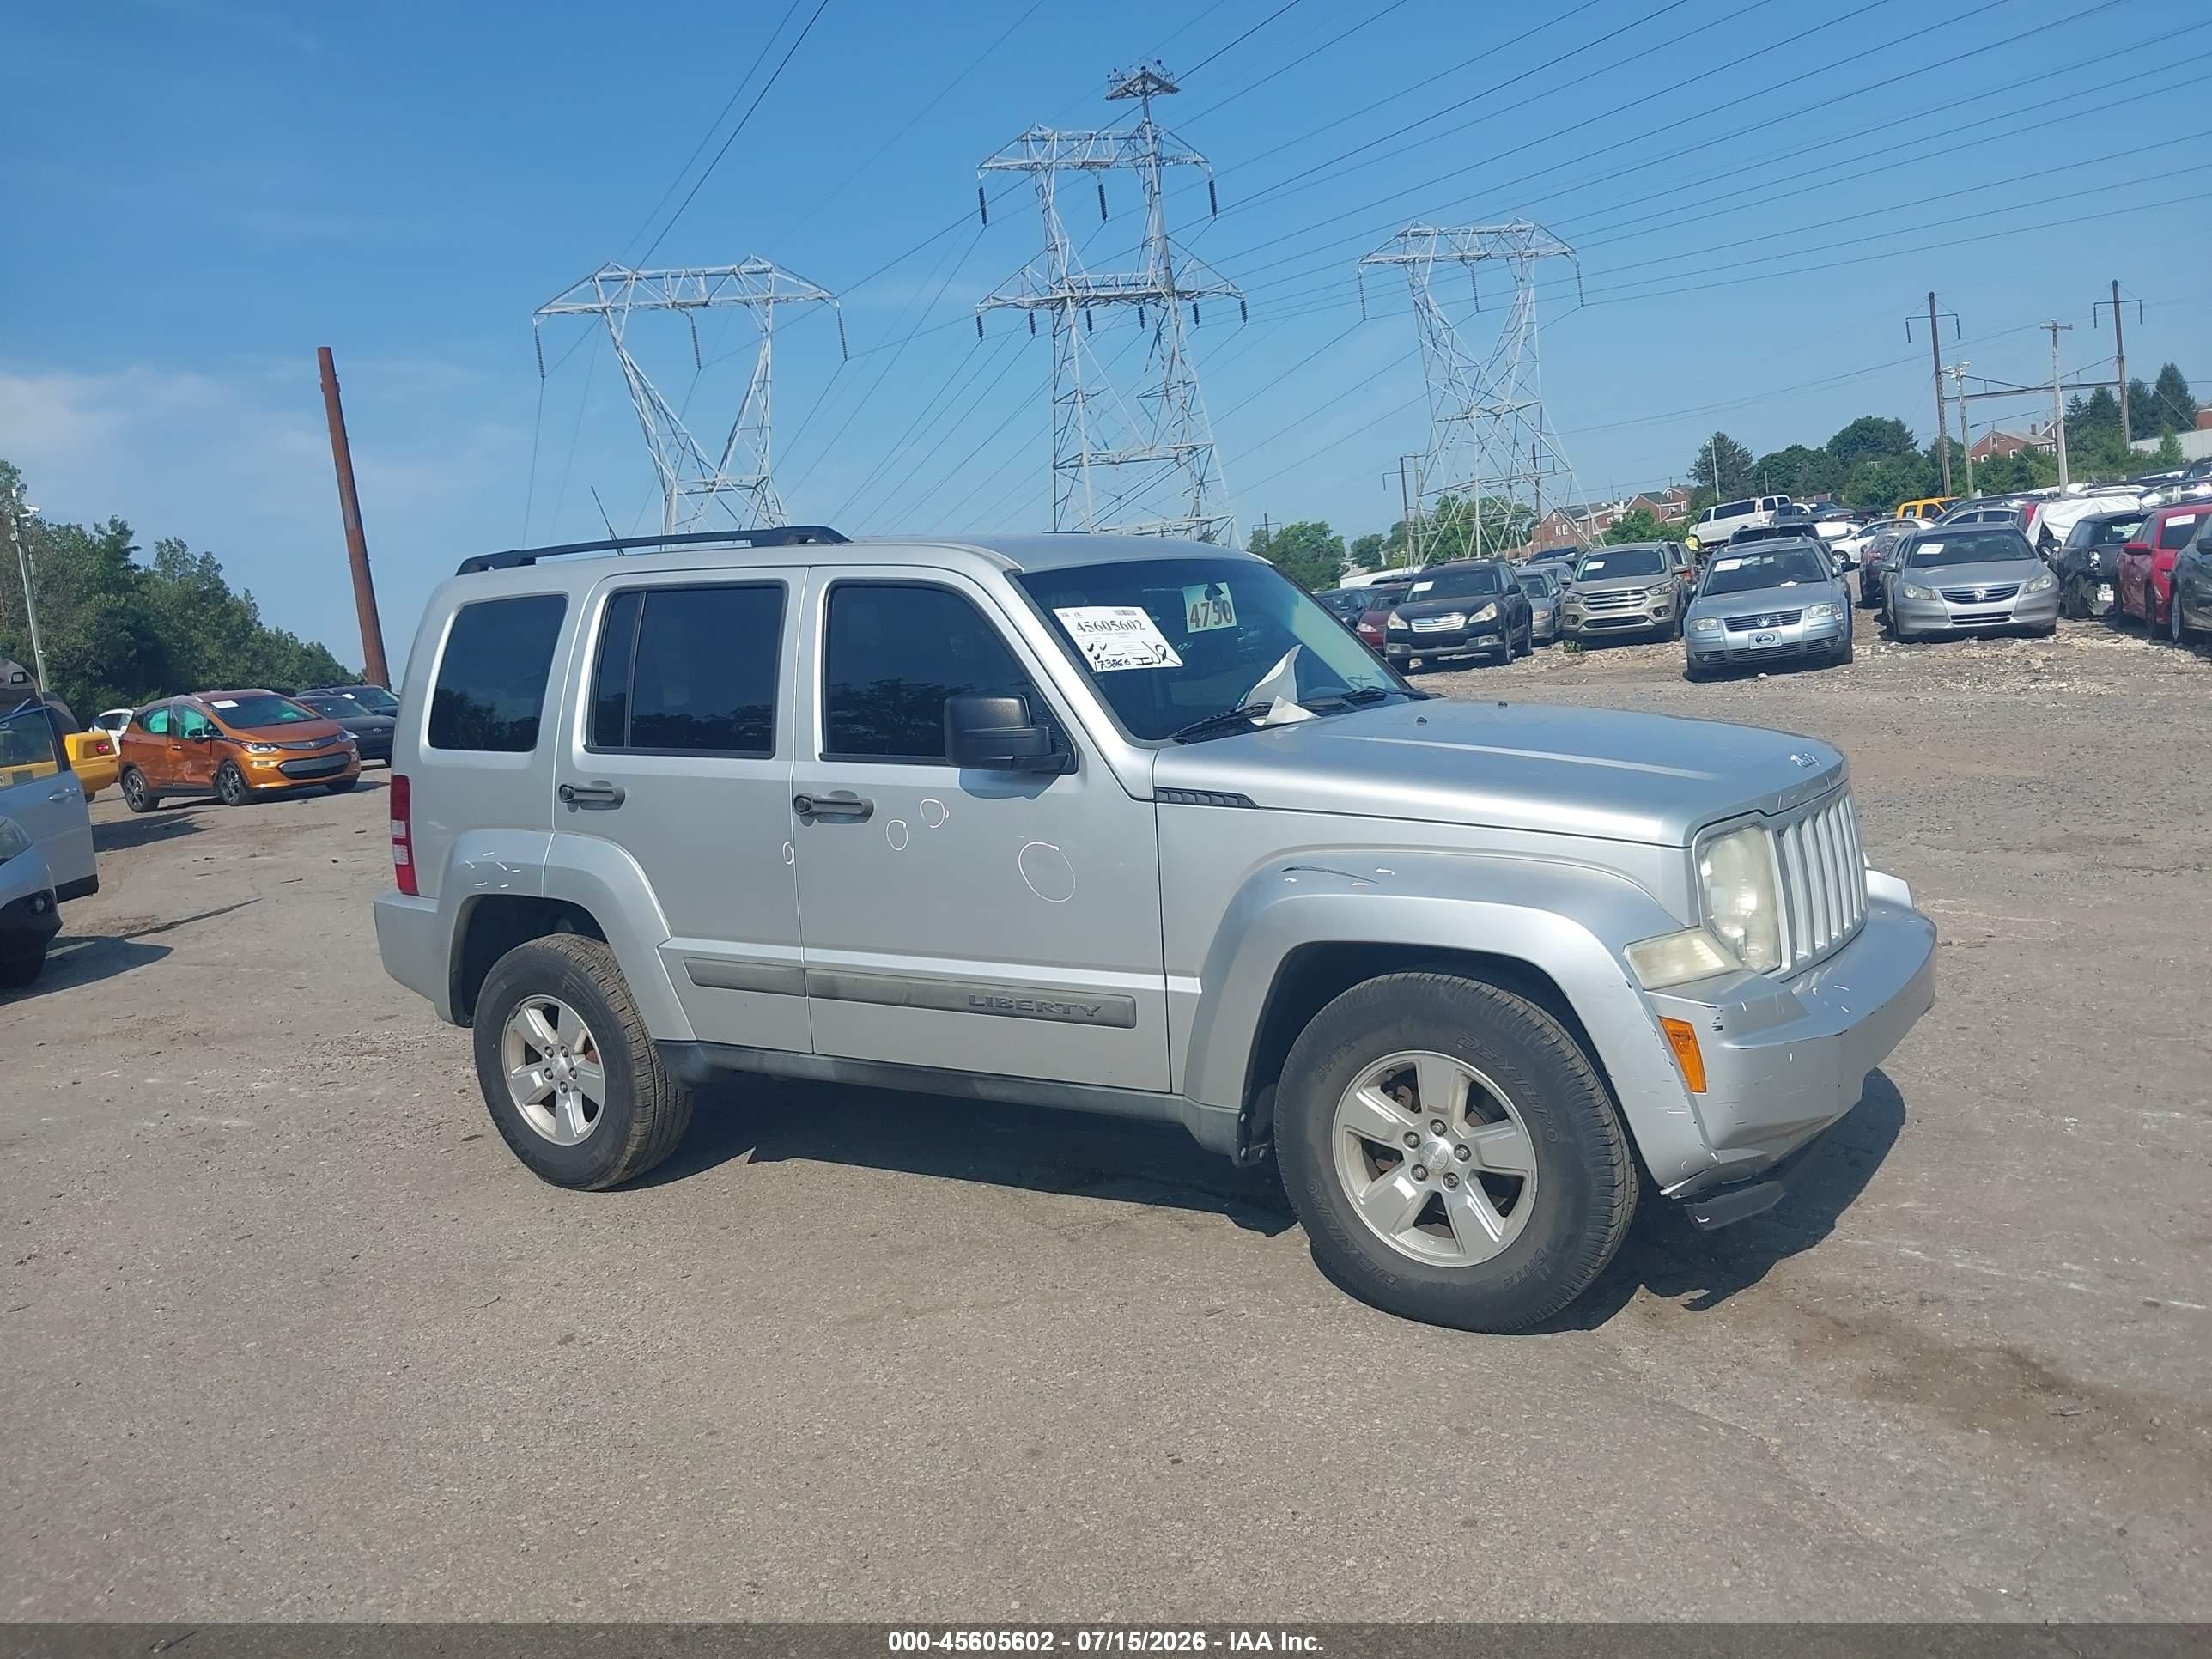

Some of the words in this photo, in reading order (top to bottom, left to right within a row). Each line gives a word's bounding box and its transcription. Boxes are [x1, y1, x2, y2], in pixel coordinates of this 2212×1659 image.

[1190, 600, 1233, 628] 4750
[1076, 619, 1146, 633] 45605602
[969, 994, 1103, 1017] LIBERTY
